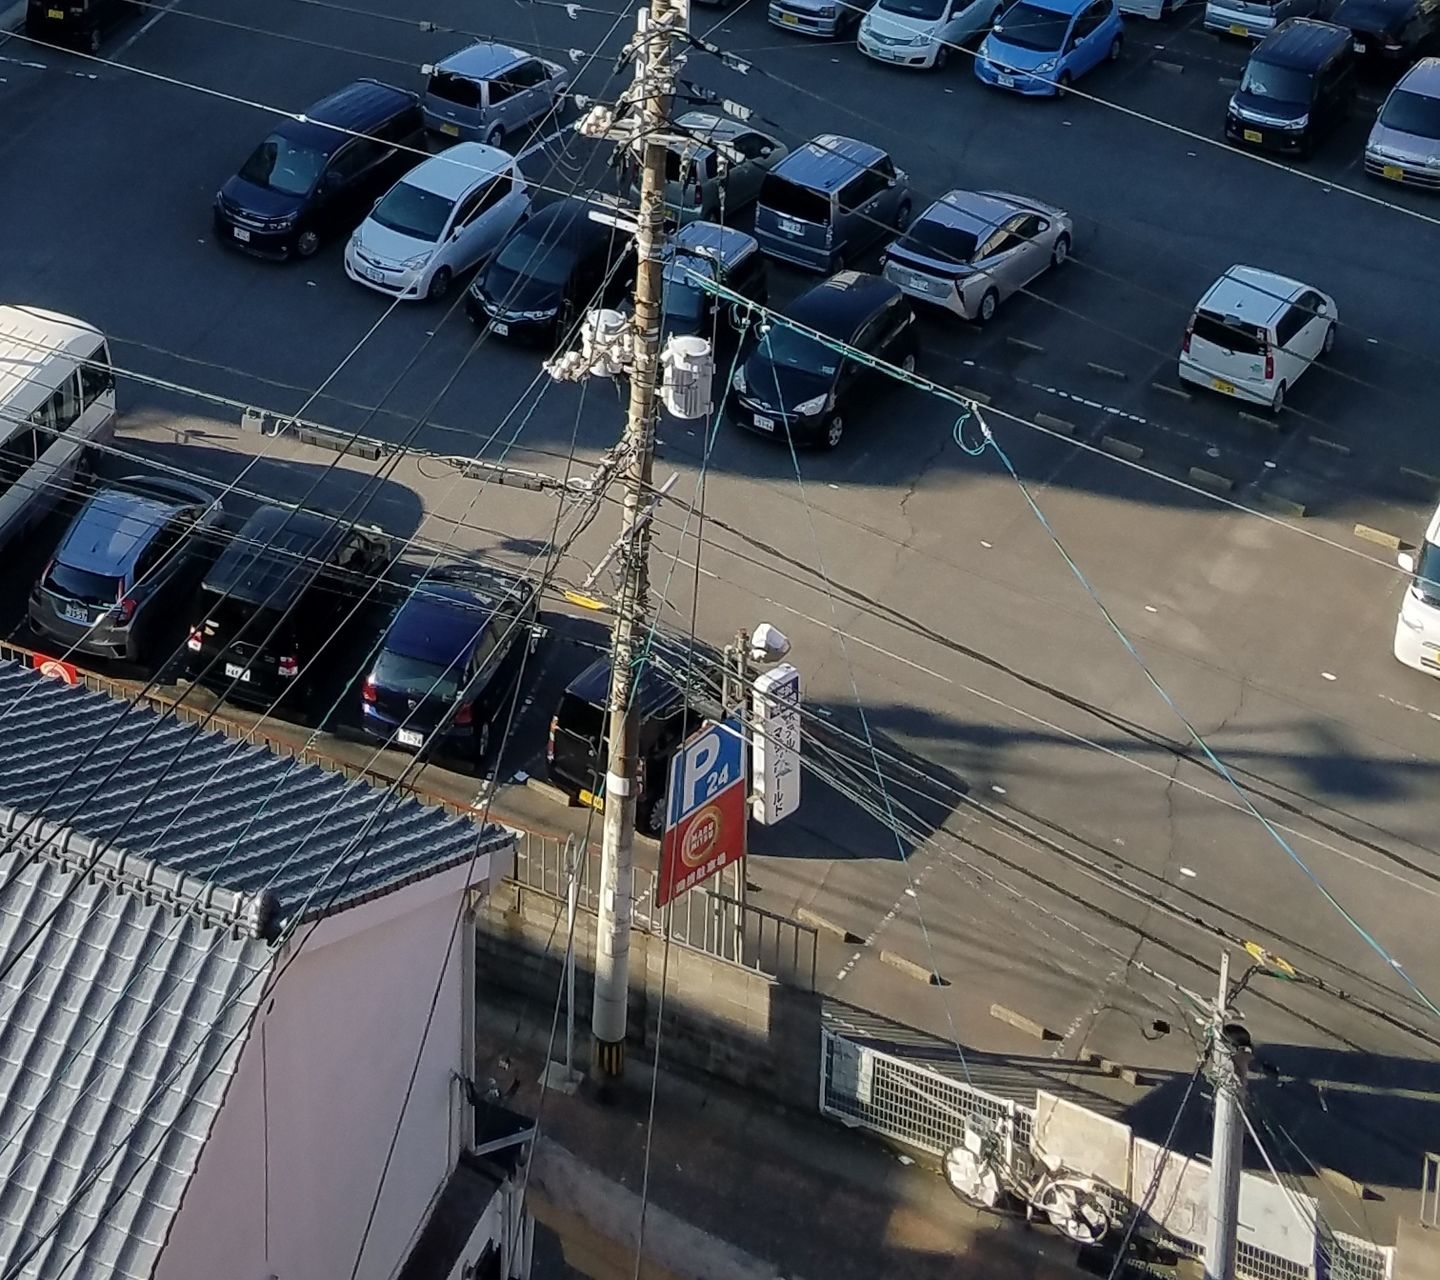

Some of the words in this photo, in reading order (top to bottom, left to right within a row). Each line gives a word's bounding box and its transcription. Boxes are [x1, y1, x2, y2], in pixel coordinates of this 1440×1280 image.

[682, 733, 721, 813] P
[706, 763, 729, 797] 24
[690, 818, 714, 842] MARU
[675, 851, 726, 894] 駐車場
